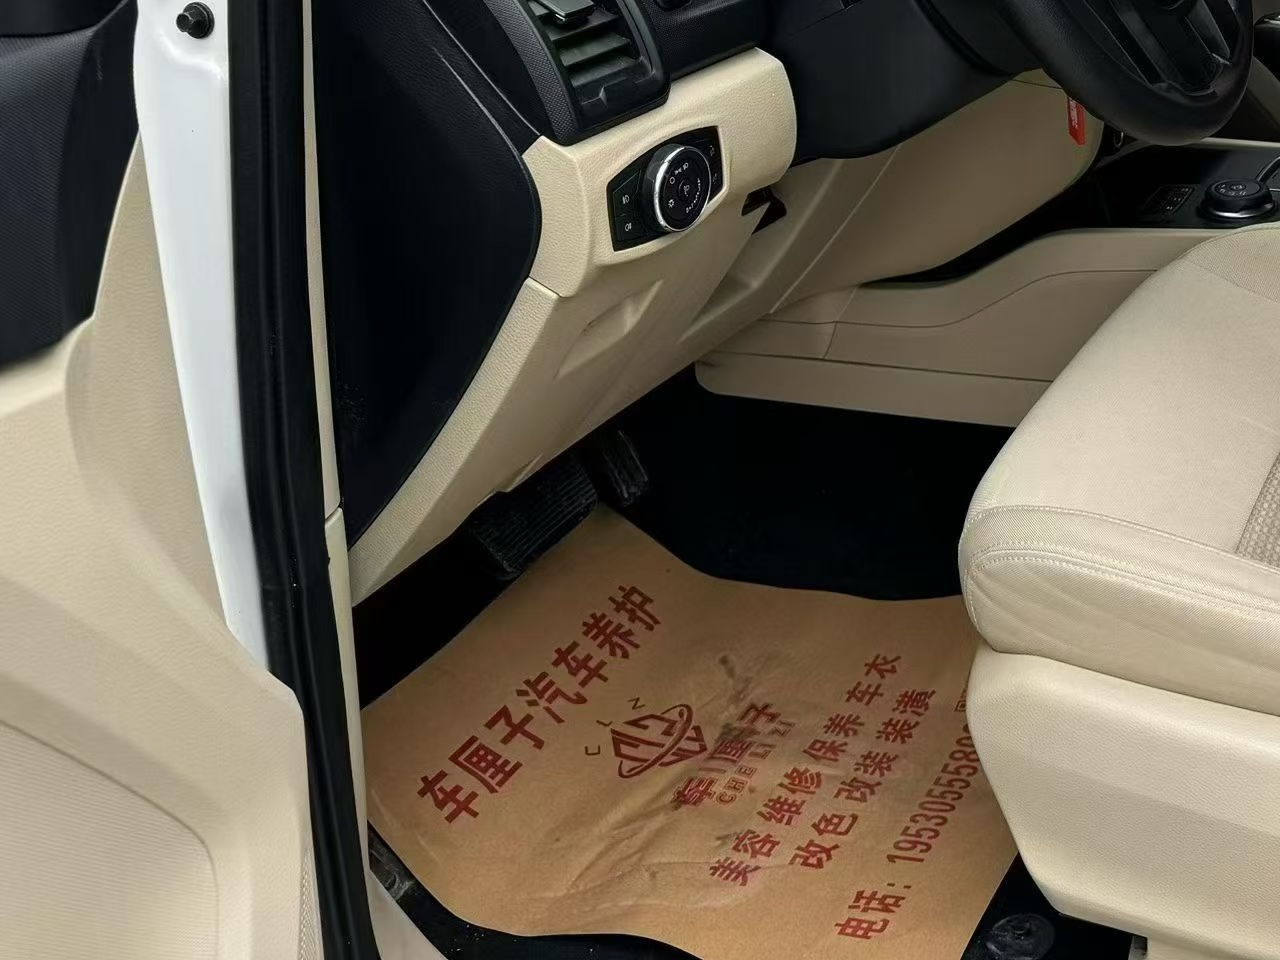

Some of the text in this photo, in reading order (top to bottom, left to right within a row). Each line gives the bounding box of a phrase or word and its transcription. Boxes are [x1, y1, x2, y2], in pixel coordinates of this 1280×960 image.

[417, 584, 662, 824] 车厘子汽车养护
[709, 653, 902, 887] 美容 维修 保养 车衣
[788, 688, 937, 871] 改色 改装 装潢
[886, 723, 980, 864] 1953055580
